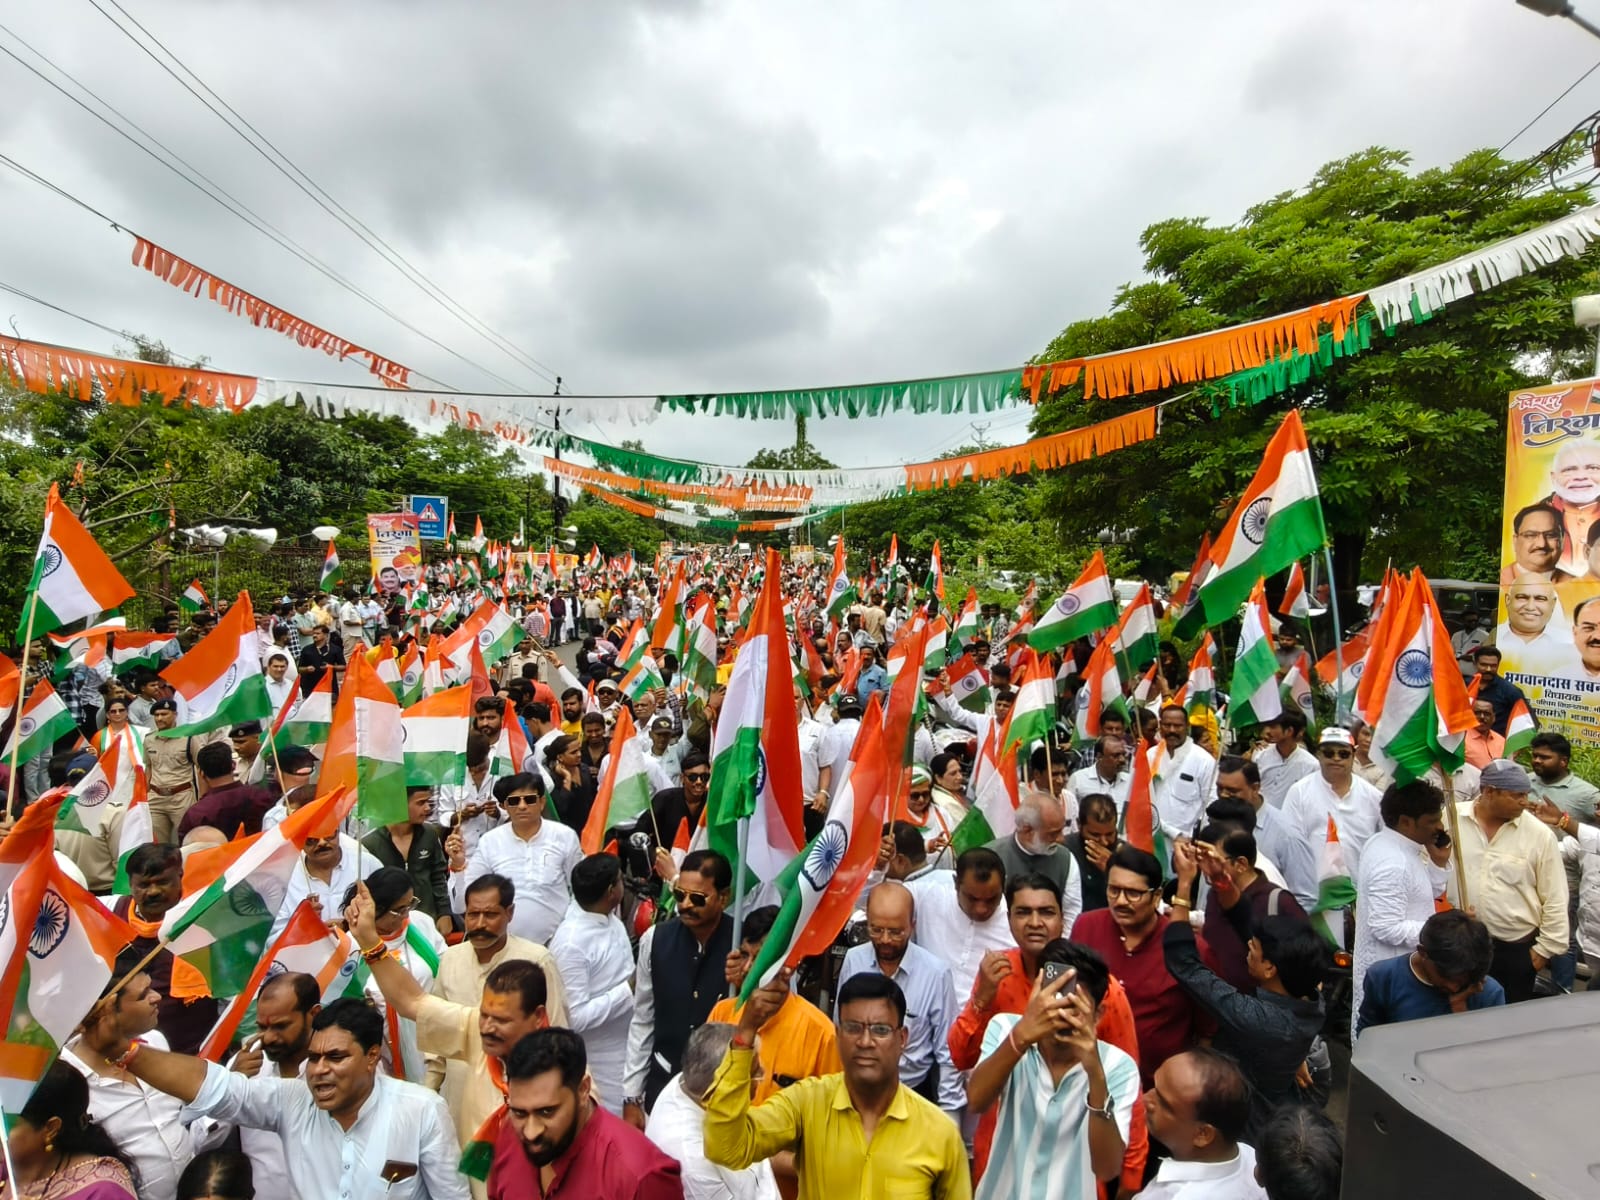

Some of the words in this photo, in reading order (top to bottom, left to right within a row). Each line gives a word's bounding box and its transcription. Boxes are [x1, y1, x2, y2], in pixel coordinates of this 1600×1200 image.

[1522, 409, 1600, 447] तिरंग
[1505, 672, 1571, 690] भगवानदास
[1544, 689, 1582, 701] विधायक
